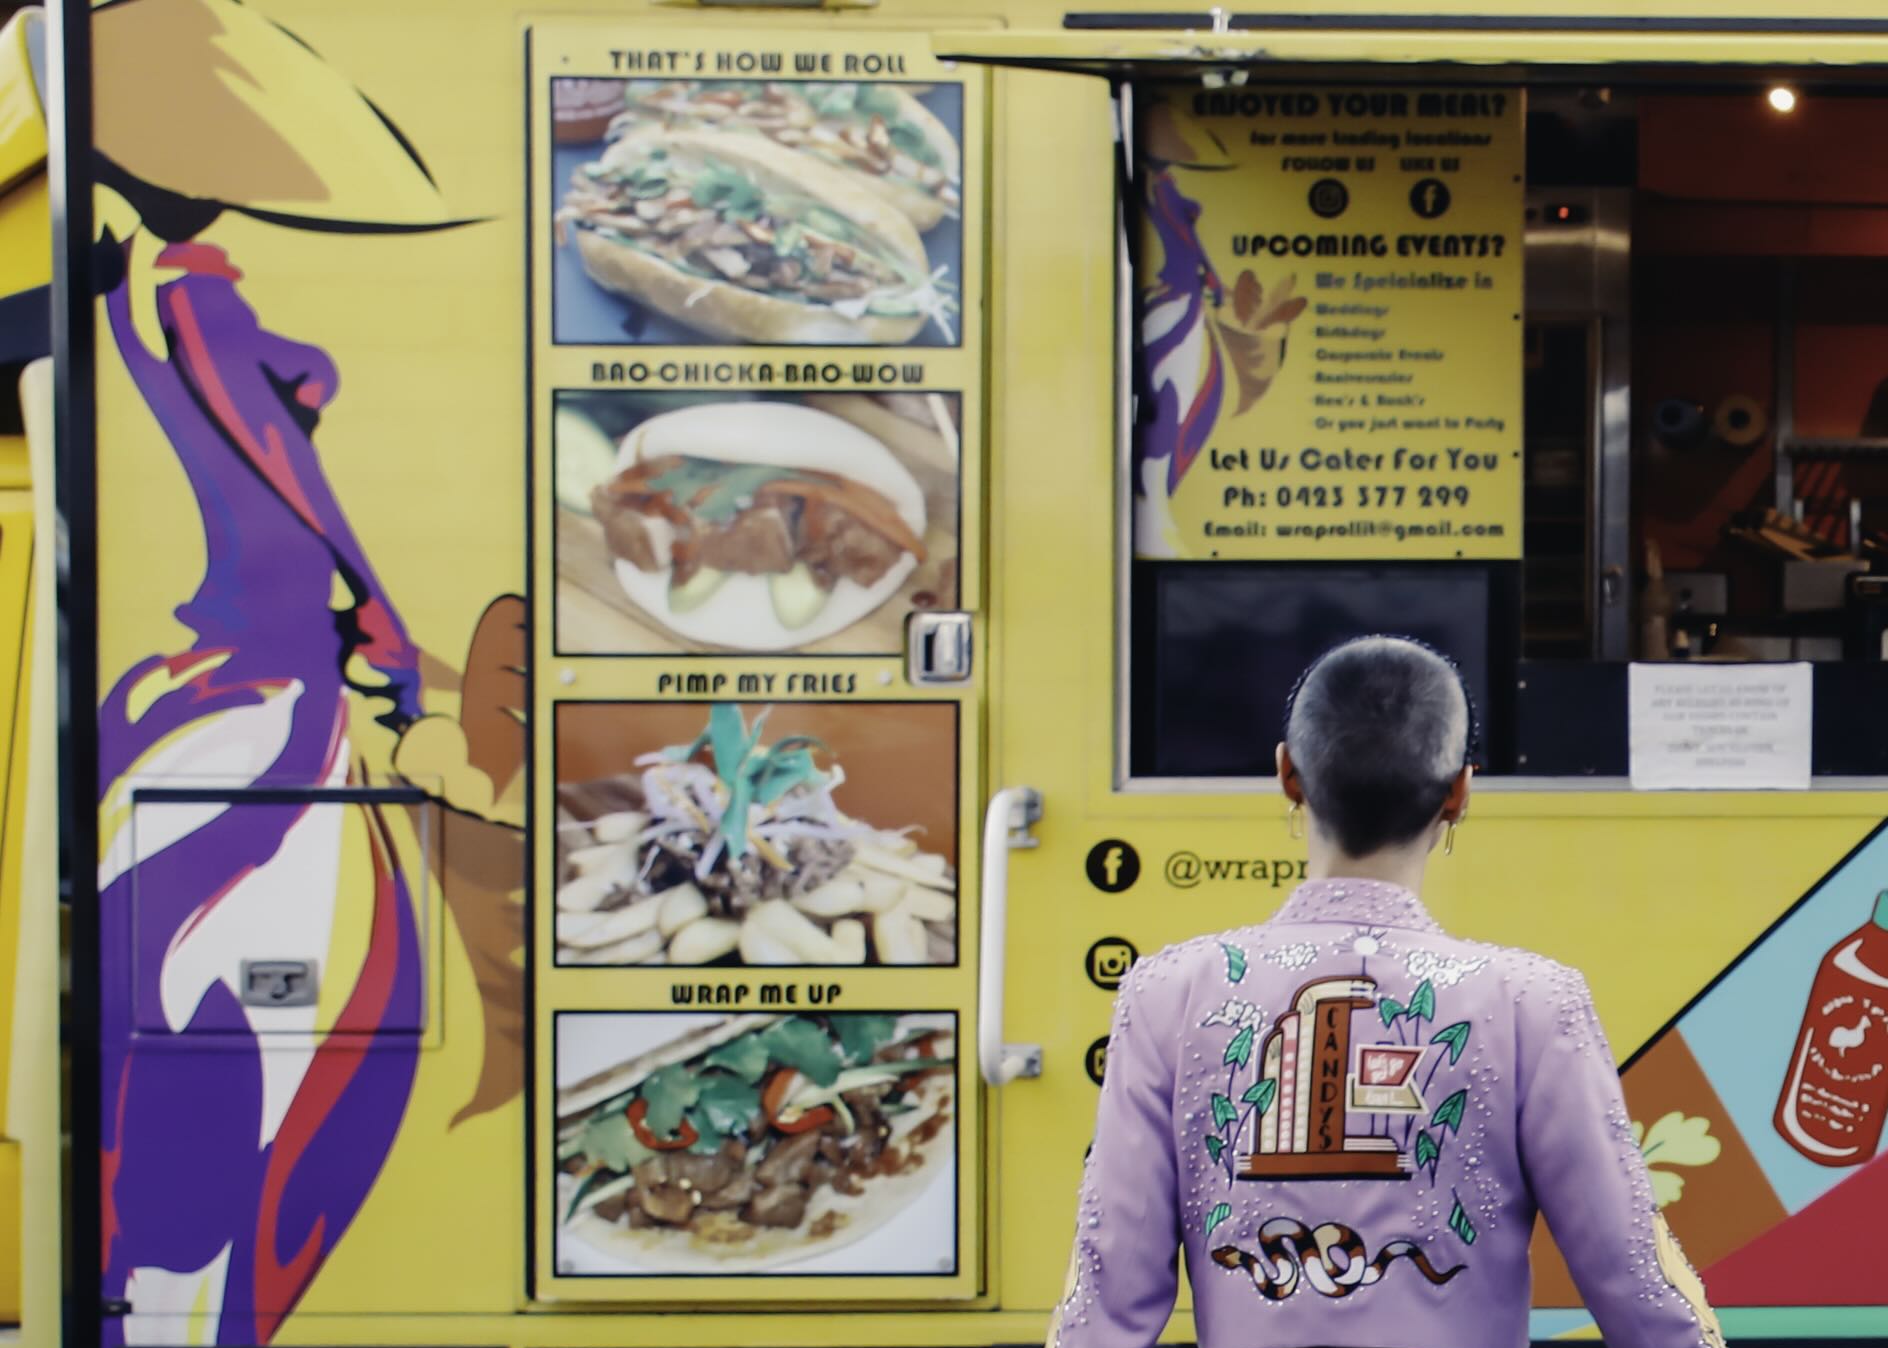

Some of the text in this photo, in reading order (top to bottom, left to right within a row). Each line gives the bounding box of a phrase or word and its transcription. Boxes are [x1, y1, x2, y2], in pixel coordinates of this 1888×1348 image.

[608, 50, 907, 74] THAT'S HOW WE ROLL
[1193, 92, 1506, 118] ENJOYED YOUR MEAL?
[1232, 233, 1506, 257] UPCOMING EVENTS?
[1315, 272, 1346, 290] We
[1210, 447, 1499, 472] Let Us Cater For You
[1223, 486, 1267, 508] Ph:
[1418, 486, 1470, 508] 299
[1204, 521, 1267, 538] Email:
[657, 672, 858, 694] PIMP MY FRIES
[670, 983, 843, 1006] WRAP ME UP
